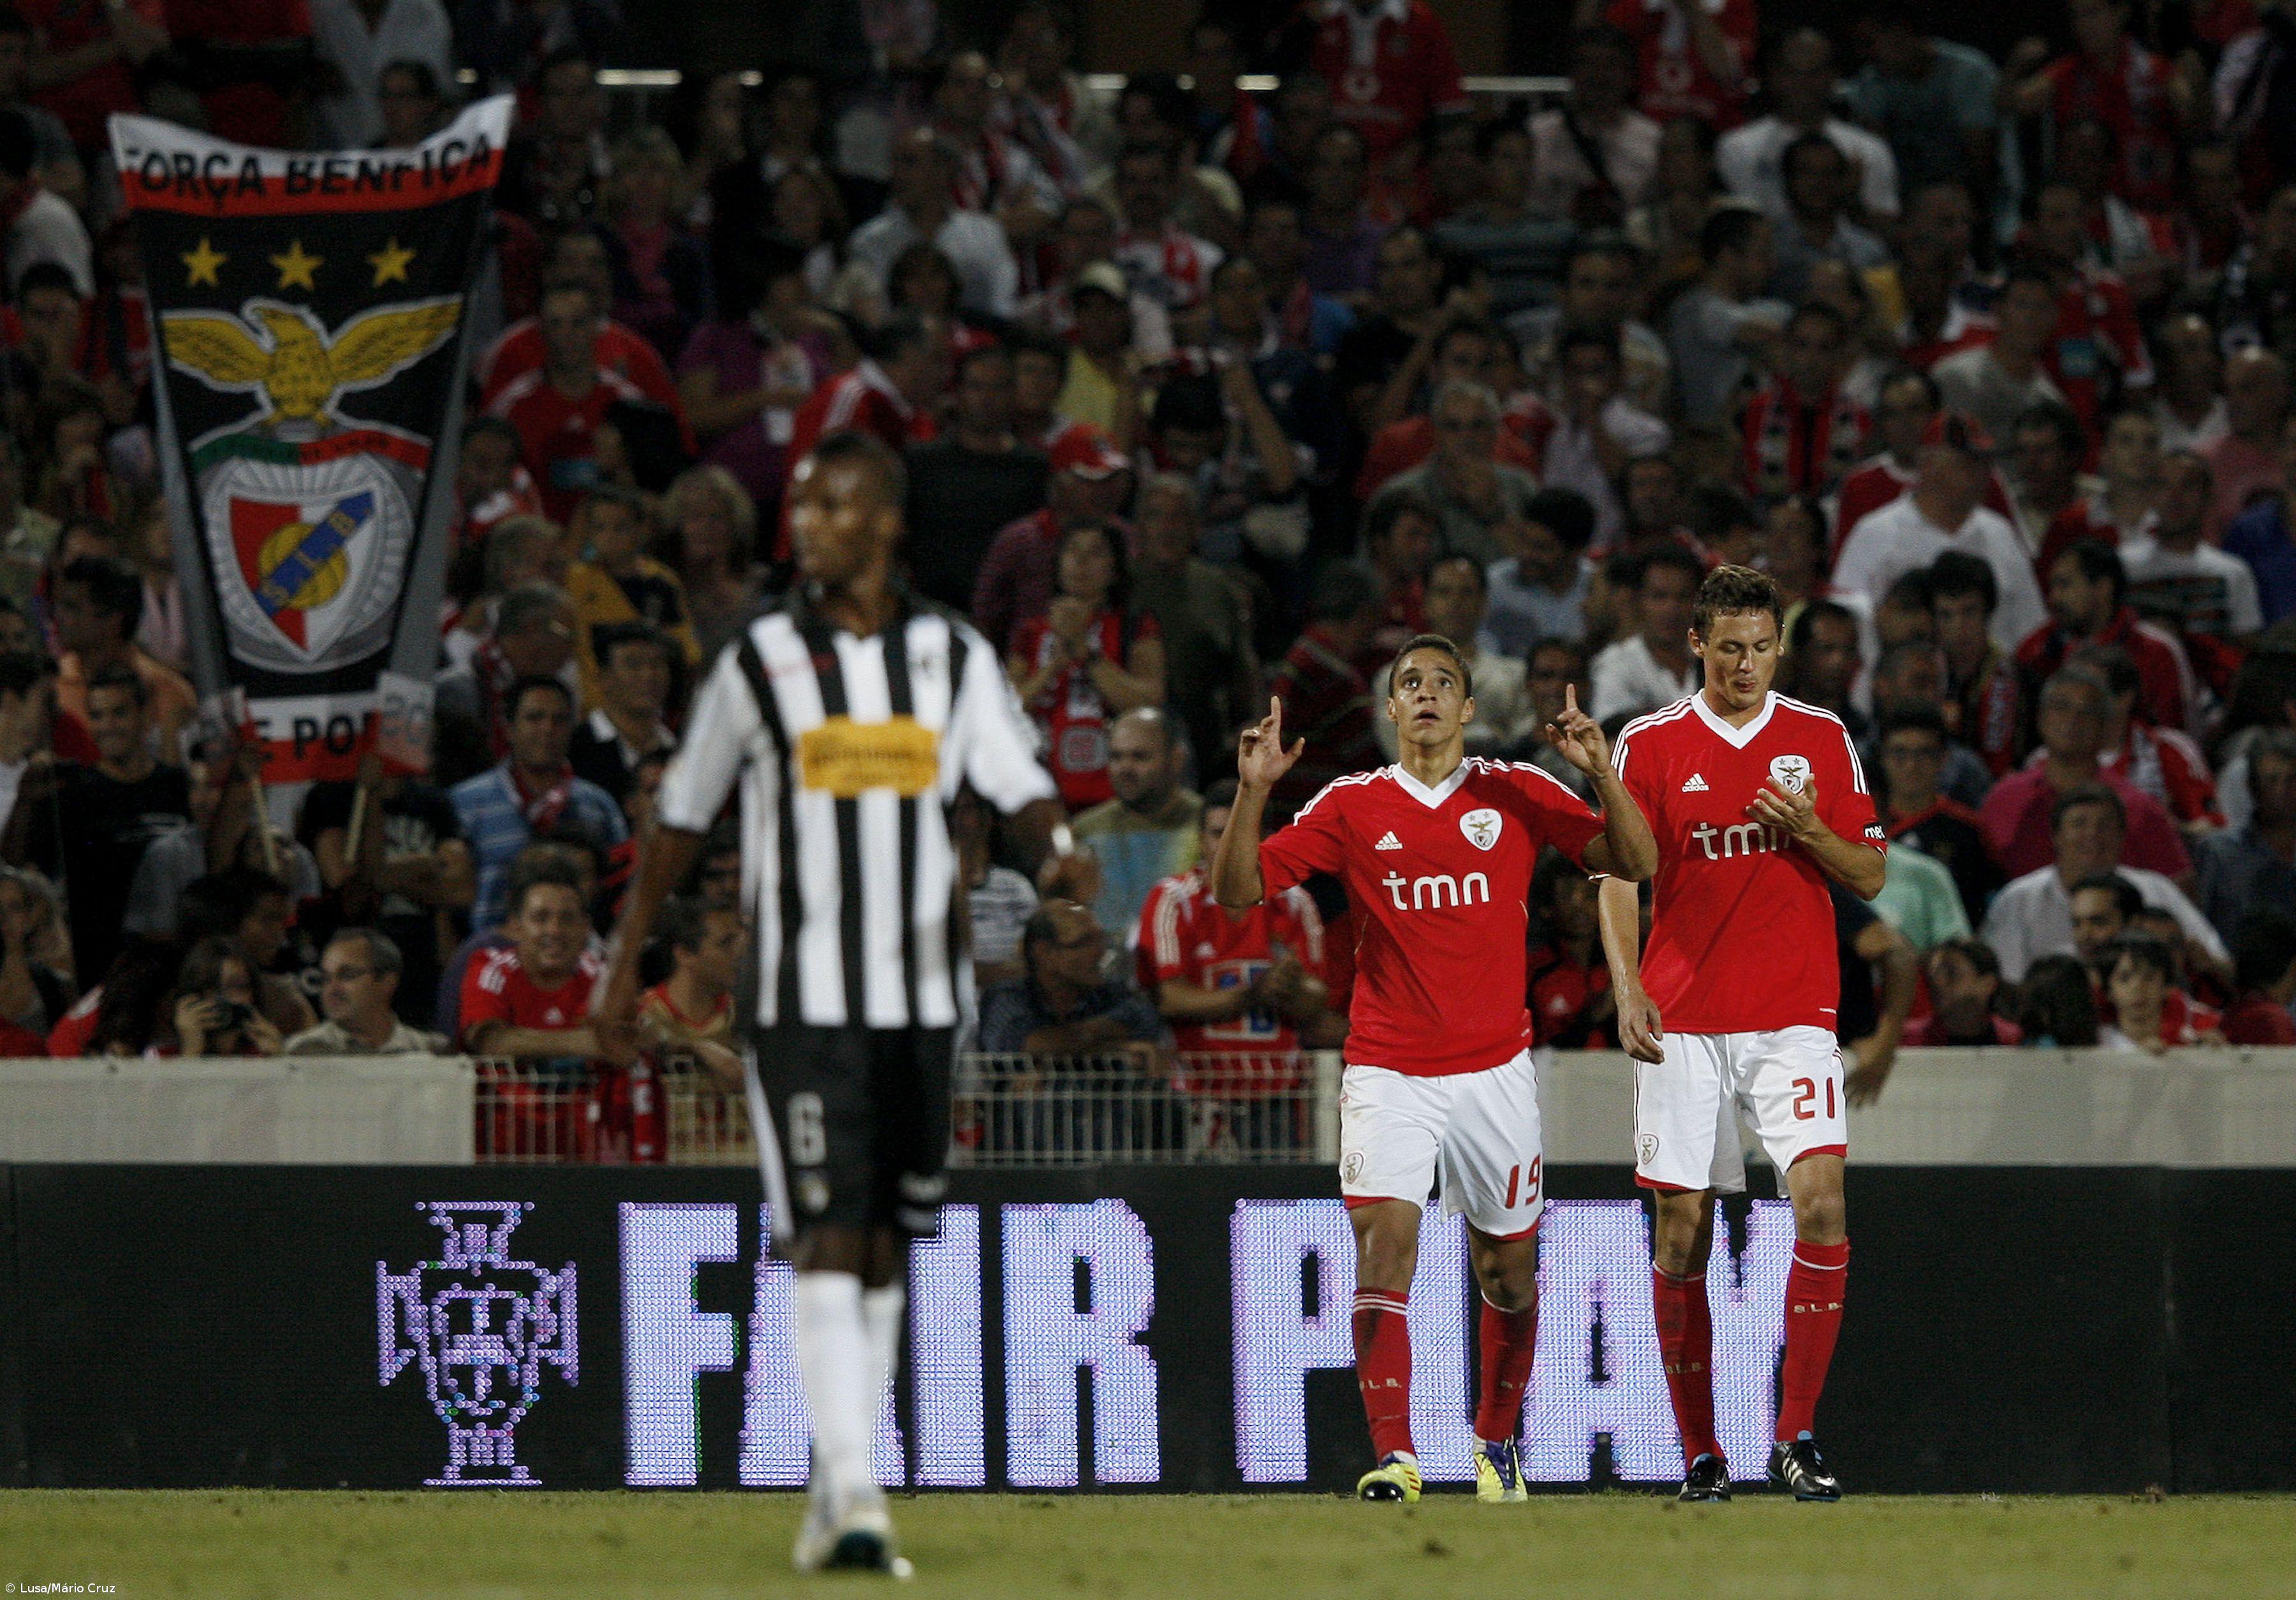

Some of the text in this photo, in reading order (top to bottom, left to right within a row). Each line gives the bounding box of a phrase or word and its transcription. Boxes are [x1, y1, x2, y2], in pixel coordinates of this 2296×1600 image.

[1382, 870, 1490, 910] tmn
[1790, 1076, 1836, 1120] 21
[787, 1091, 827, 1167] 6
[1504, 1153, 1541, 1209] 19
